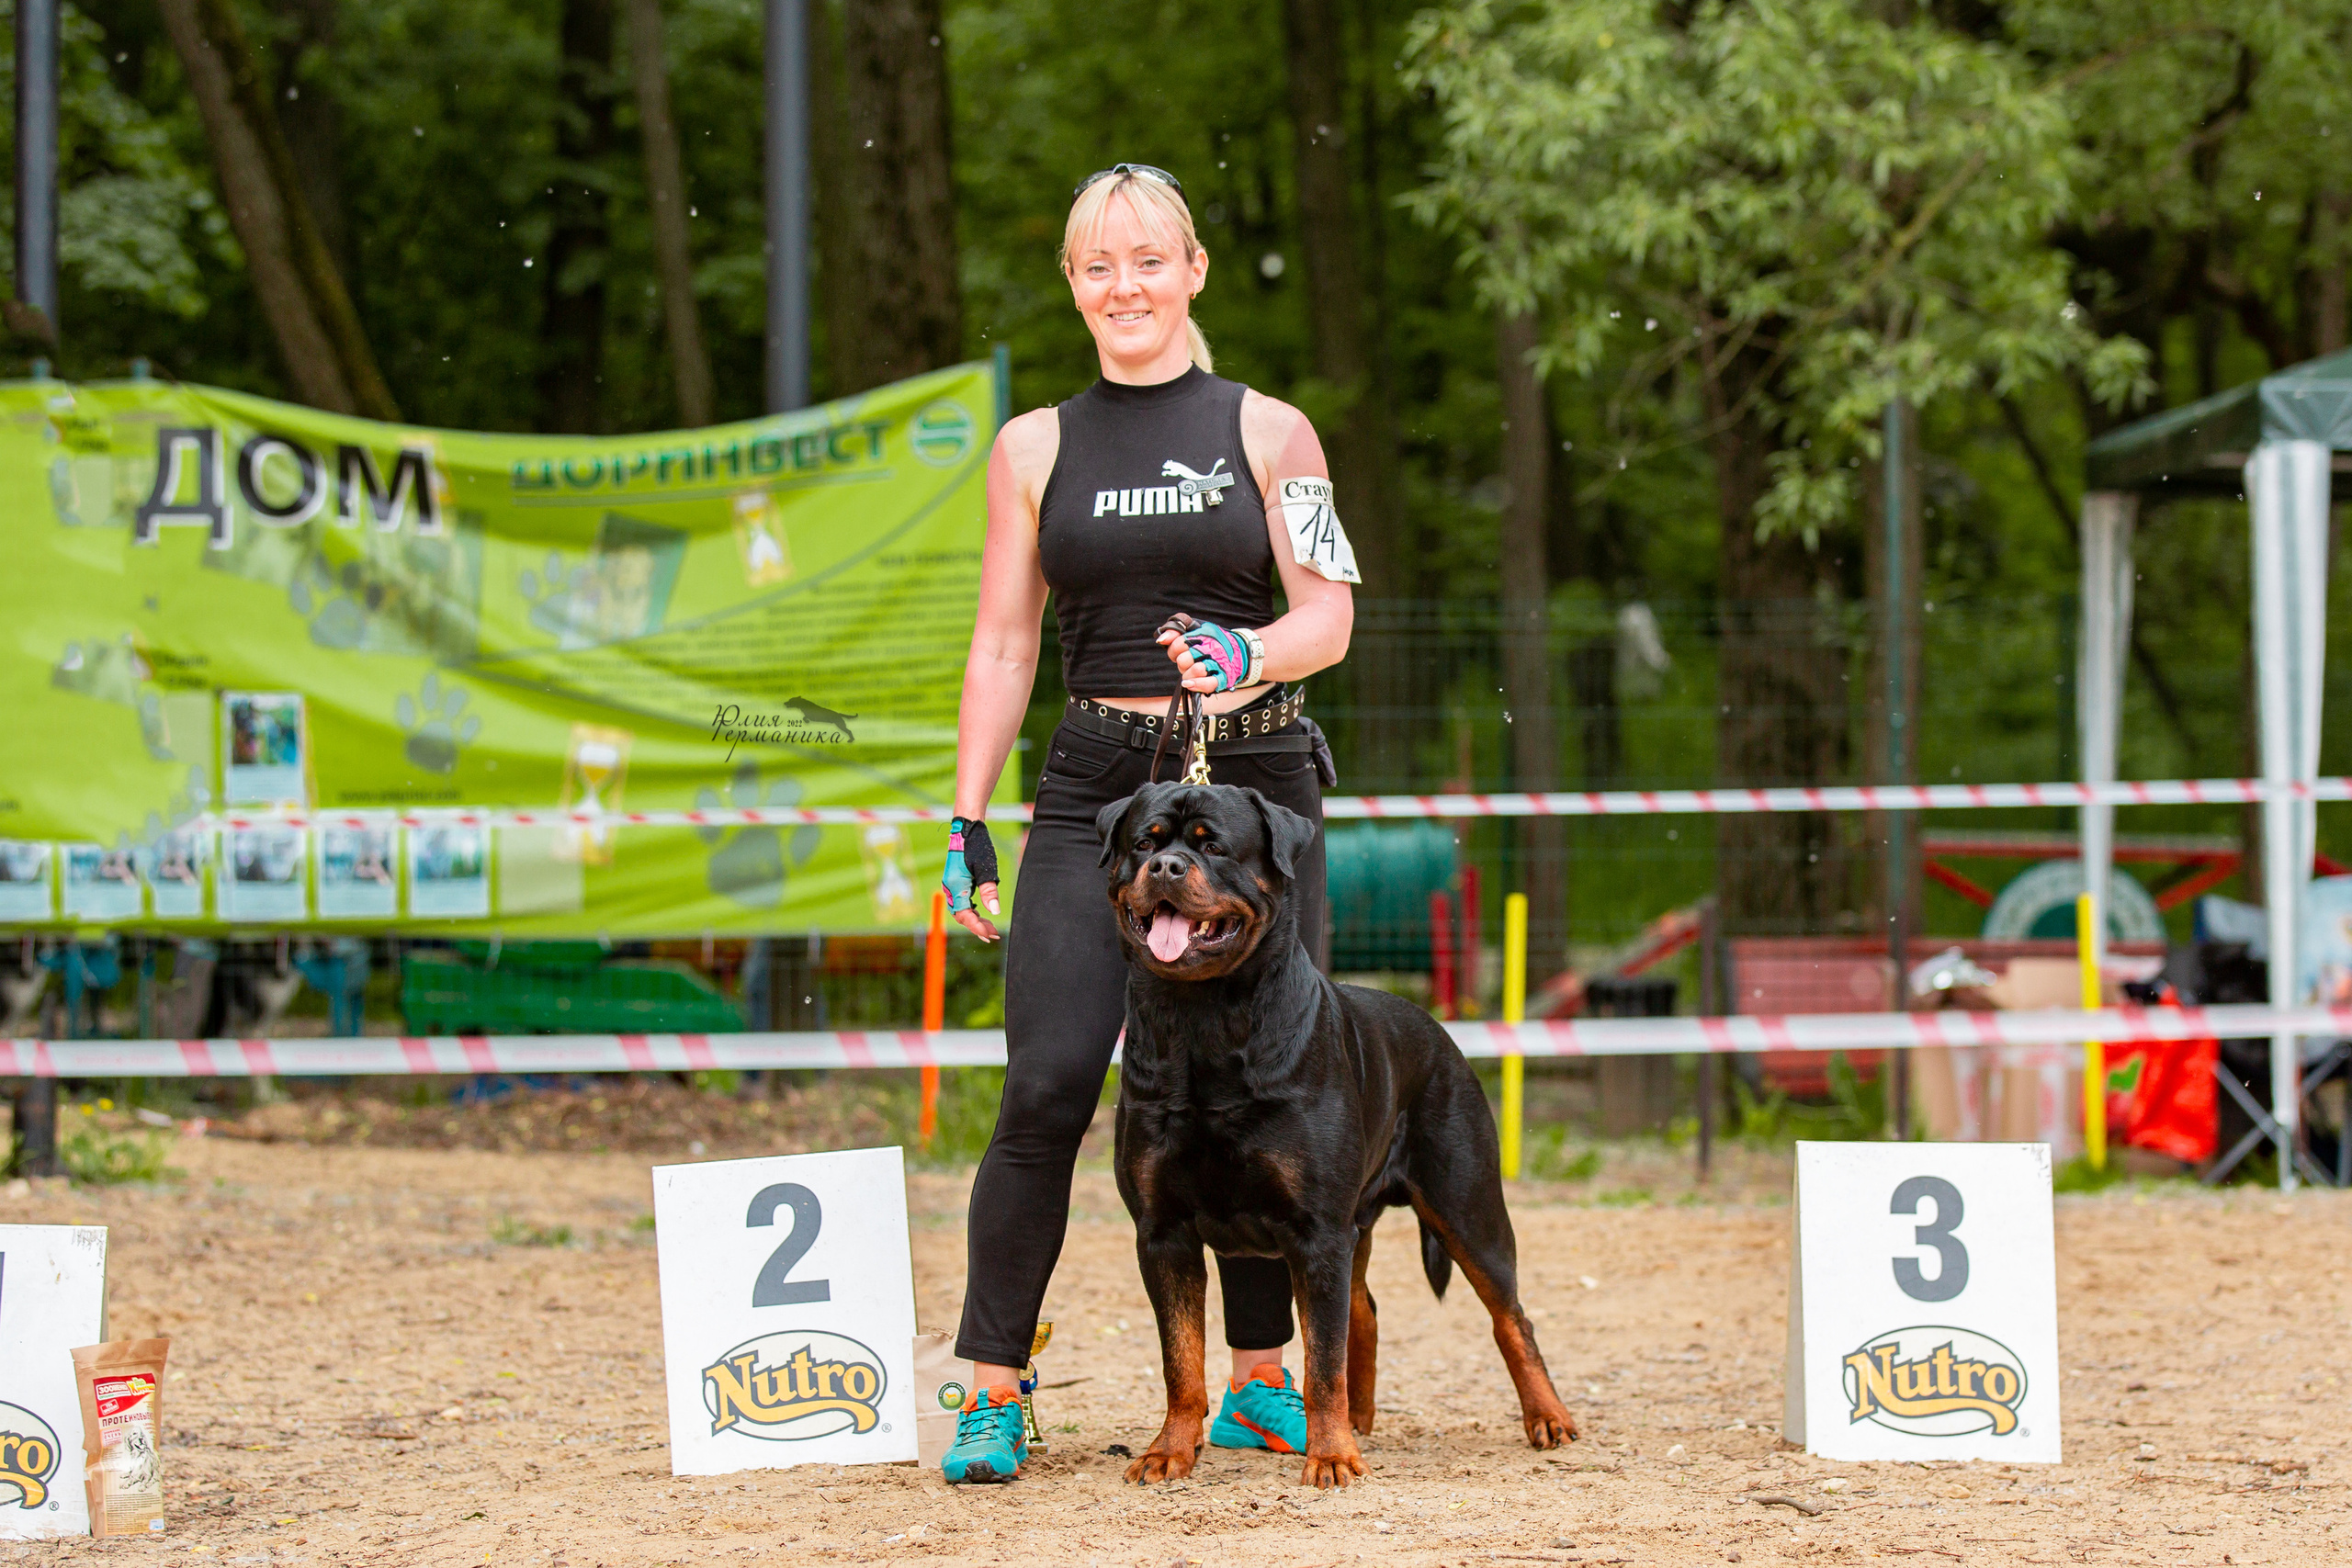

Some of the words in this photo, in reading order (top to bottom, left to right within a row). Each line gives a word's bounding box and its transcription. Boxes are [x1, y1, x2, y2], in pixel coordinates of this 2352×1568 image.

[136, 428, 440, 546] ДОМ
[1093, 486, 1204, 517] PUMA
[1299, 503, 1335, 562] 14
[746, 1182, 831, 1308] 2
[1890, 1175, 1970, 1303] 3
[702, 1344, 880, 1437] Nutro
[1842, 1340, 2020, 1437] Nutro
